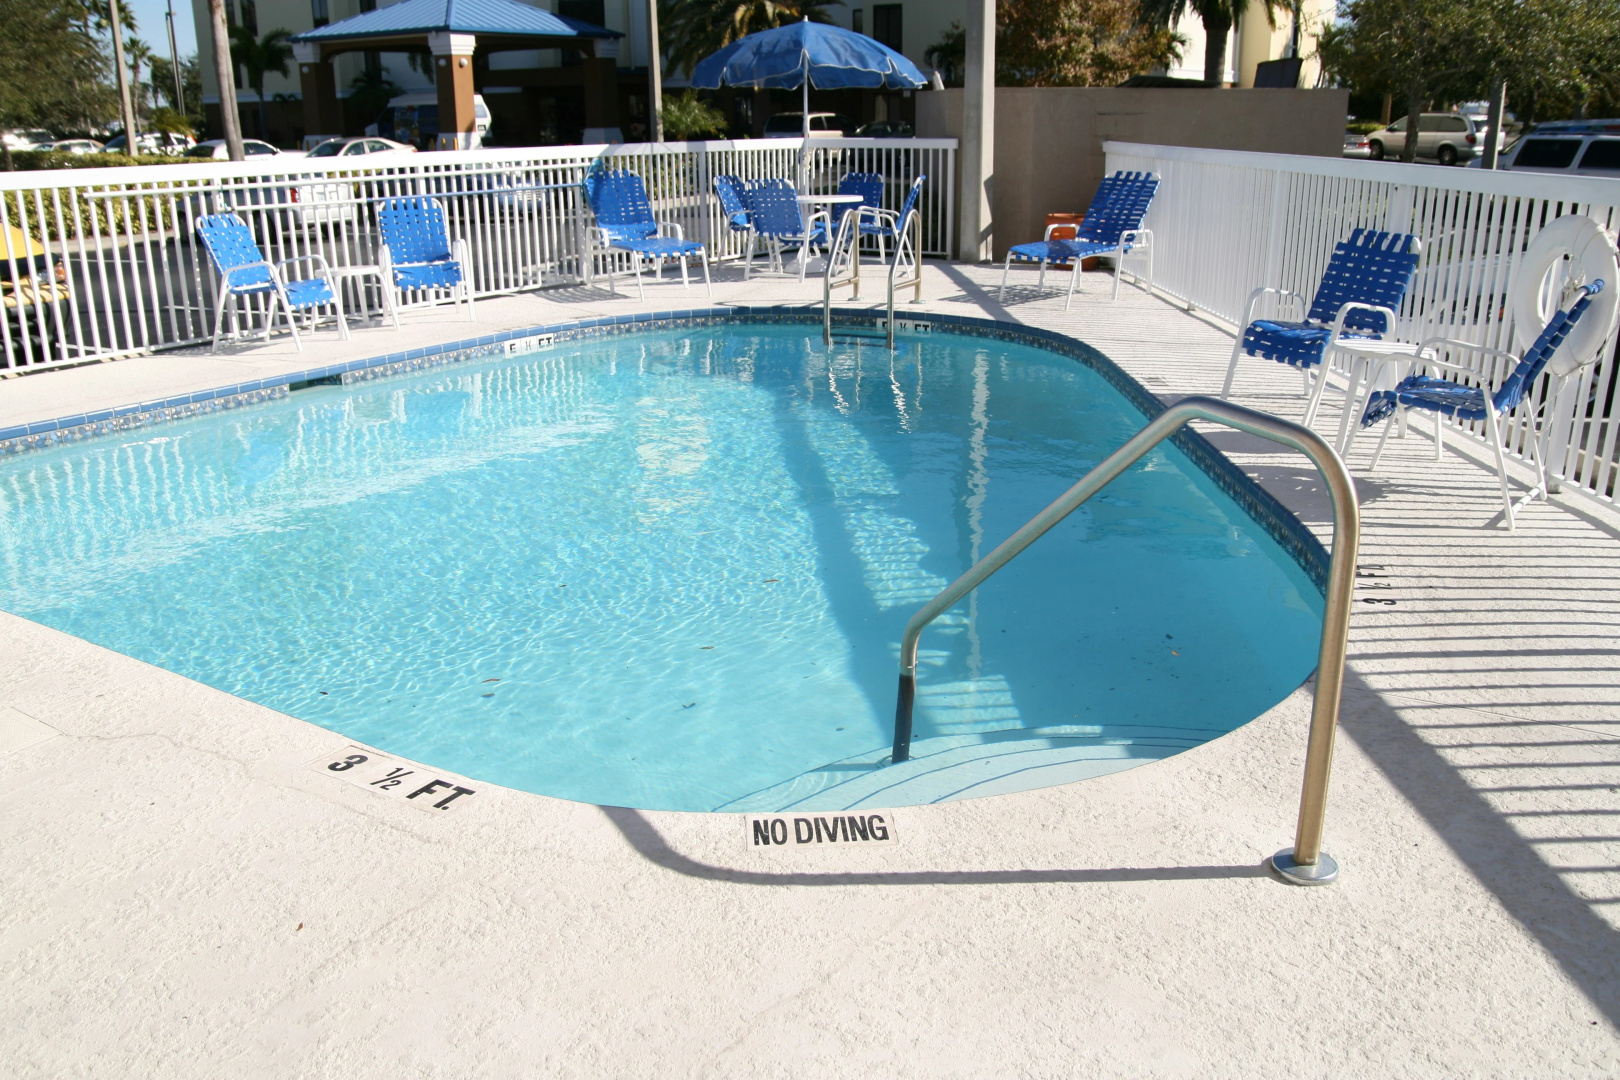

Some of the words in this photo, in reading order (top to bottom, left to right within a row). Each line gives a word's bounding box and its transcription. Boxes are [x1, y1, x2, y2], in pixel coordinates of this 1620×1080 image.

[327, 754, 369, 772] 3
[752, 818, 788, 845] NO
[793, 814, 889, 844] DIVING
